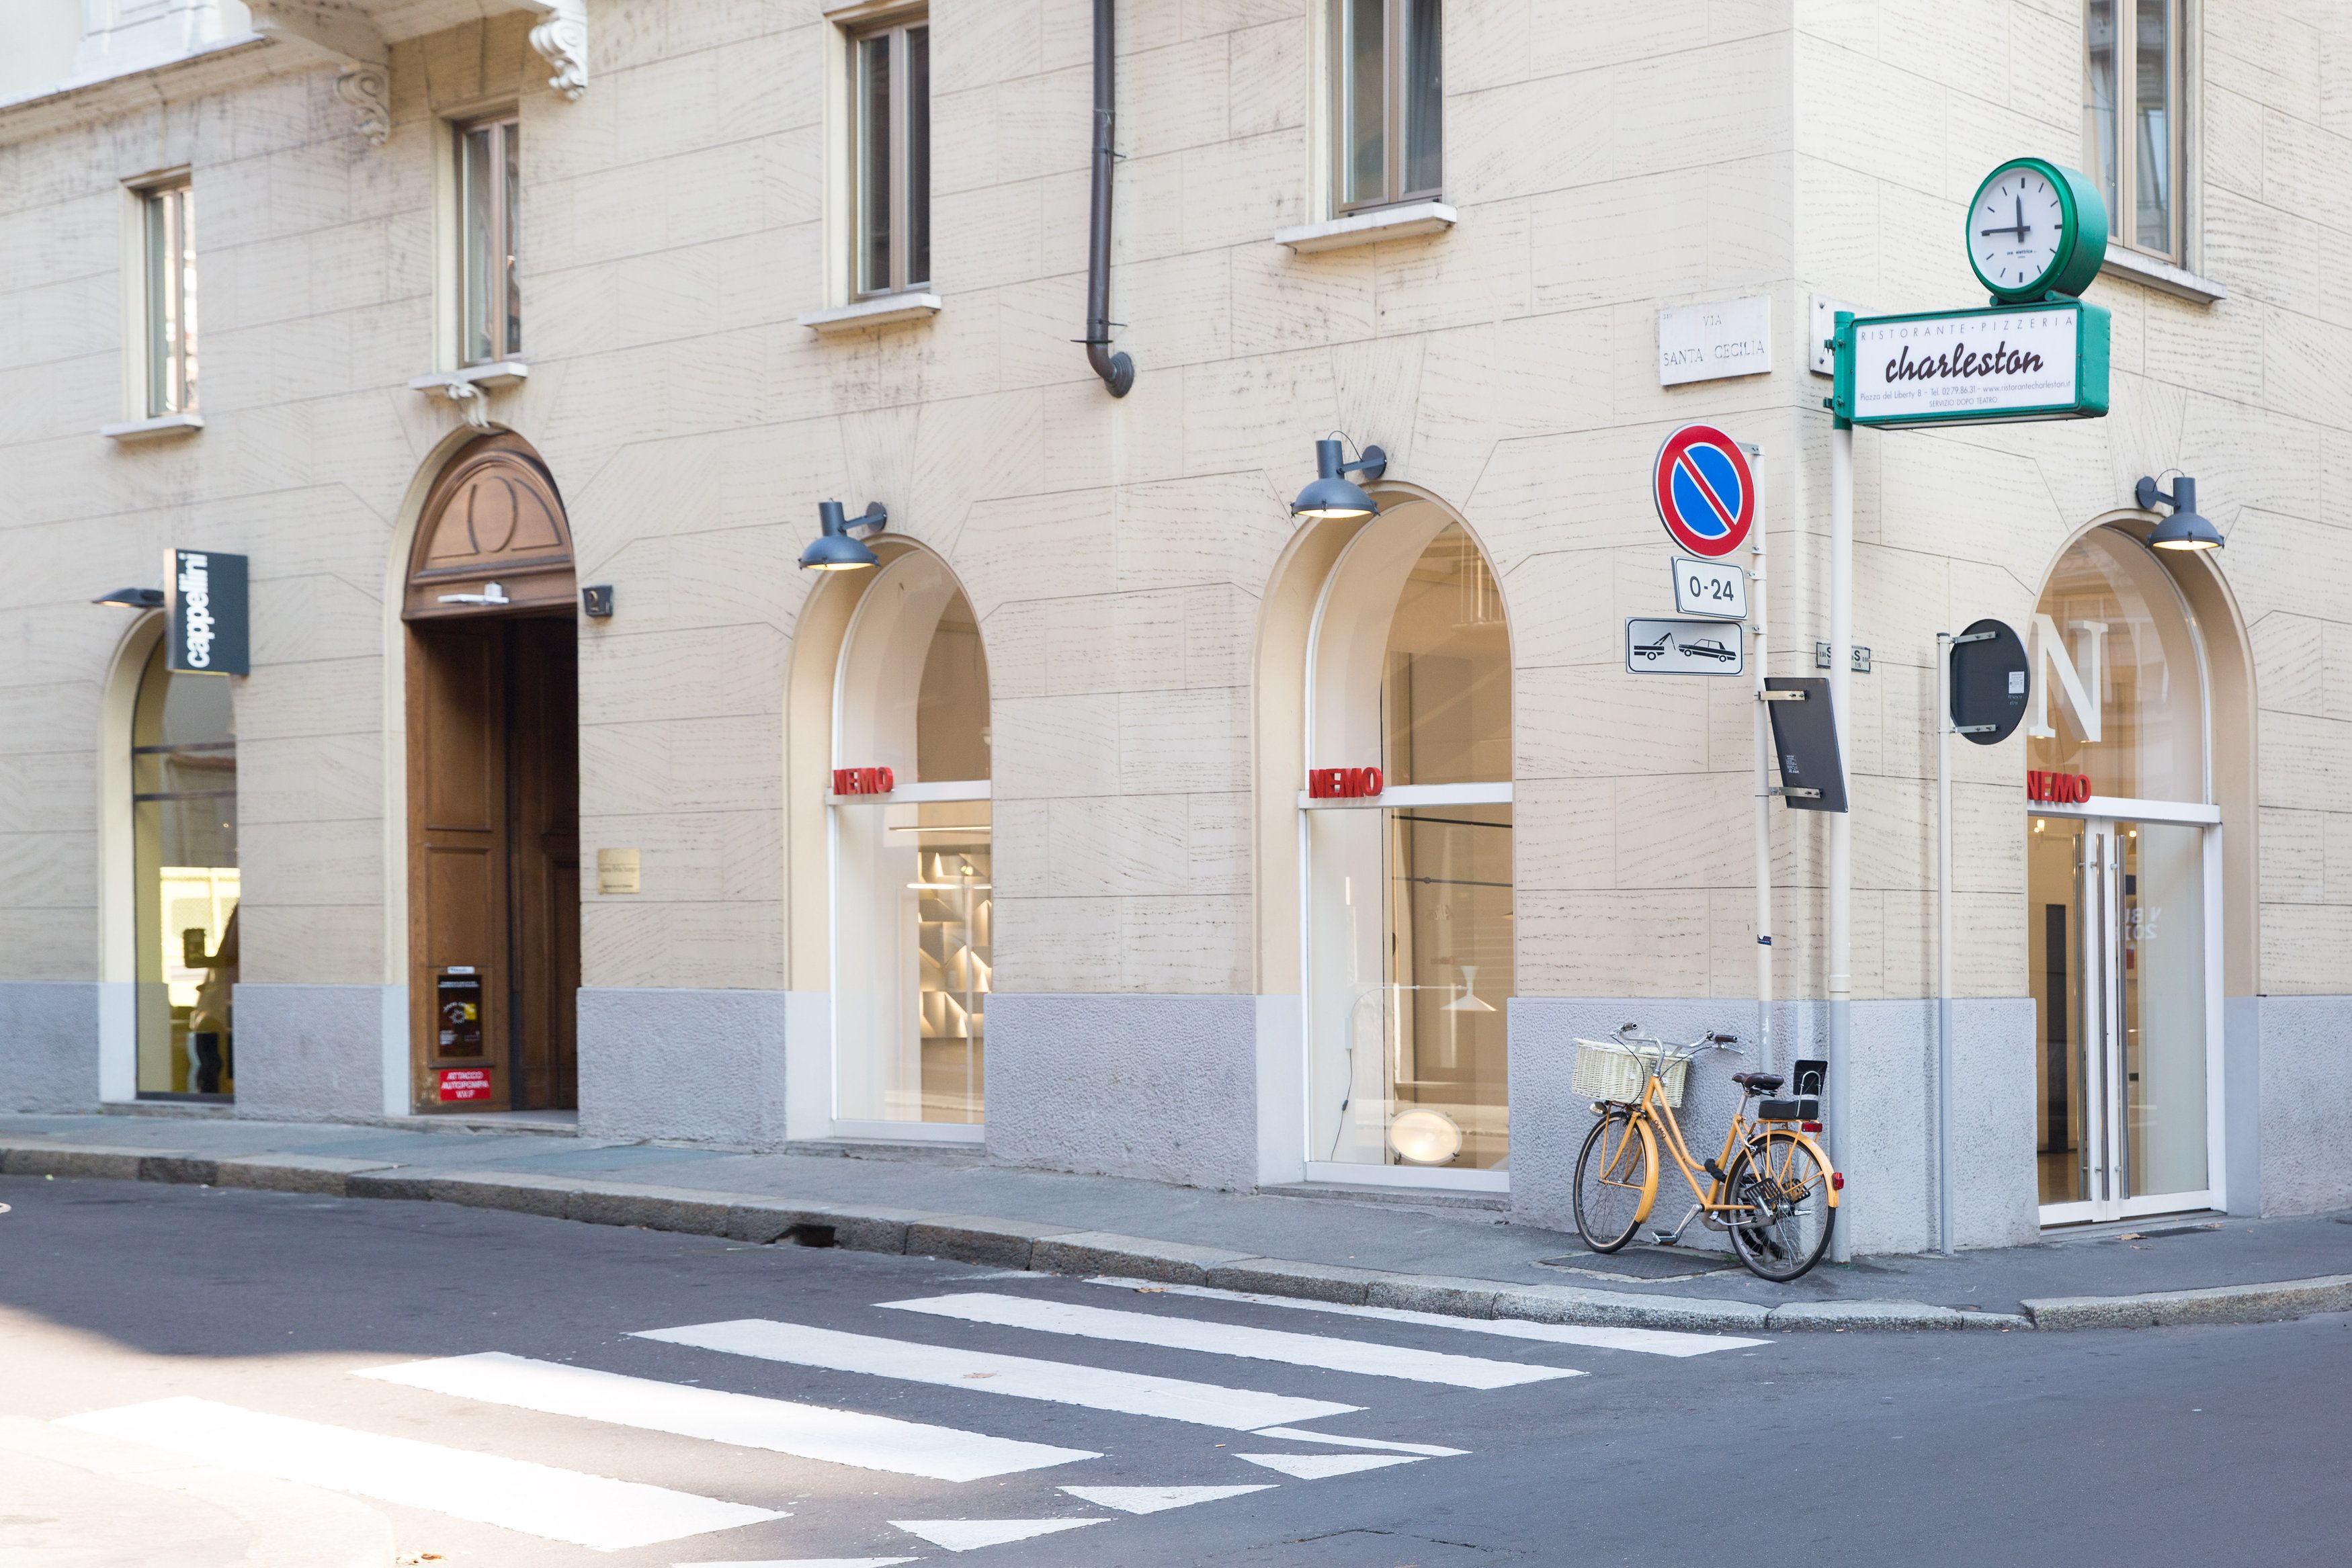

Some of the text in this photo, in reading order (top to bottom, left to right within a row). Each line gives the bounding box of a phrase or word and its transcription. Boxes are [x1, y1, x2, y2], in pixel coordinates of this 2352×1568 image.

[1703, 314, 1722, 326] VIA
[1861, 316, 2072, 341] RISTORANTE PIZZERIA
[1663, 340, 1765, 367] SANTA CECILIA
[1886, 341, 2044, 383] charleston
[1860, 392, 1881, 401] Piazza
[1882, 390, 1892, 400] del
[1894, 390, 1915, 399] Liberty
[1917, 389, 1922, 397] 8
[1931, 387, 1939, 396] Tel.
[1982, 380, 2071, 392] www.ristorantecharleston.it
[1929, 396, 1998, 408] SERVIZIO DOPO TEATRO
[1689, 576, 1734, 601] 0-24
[178, 552, 215, 668] cappellini
[2028, 612, 2109, 742] N
[833, 767, 894, 795] NEMO
[1309, 767, 1384, 798] NEMO
[2027, 770, 2091, 803] NEMO
[1654, 1119, 1667, 1139] OLMO
